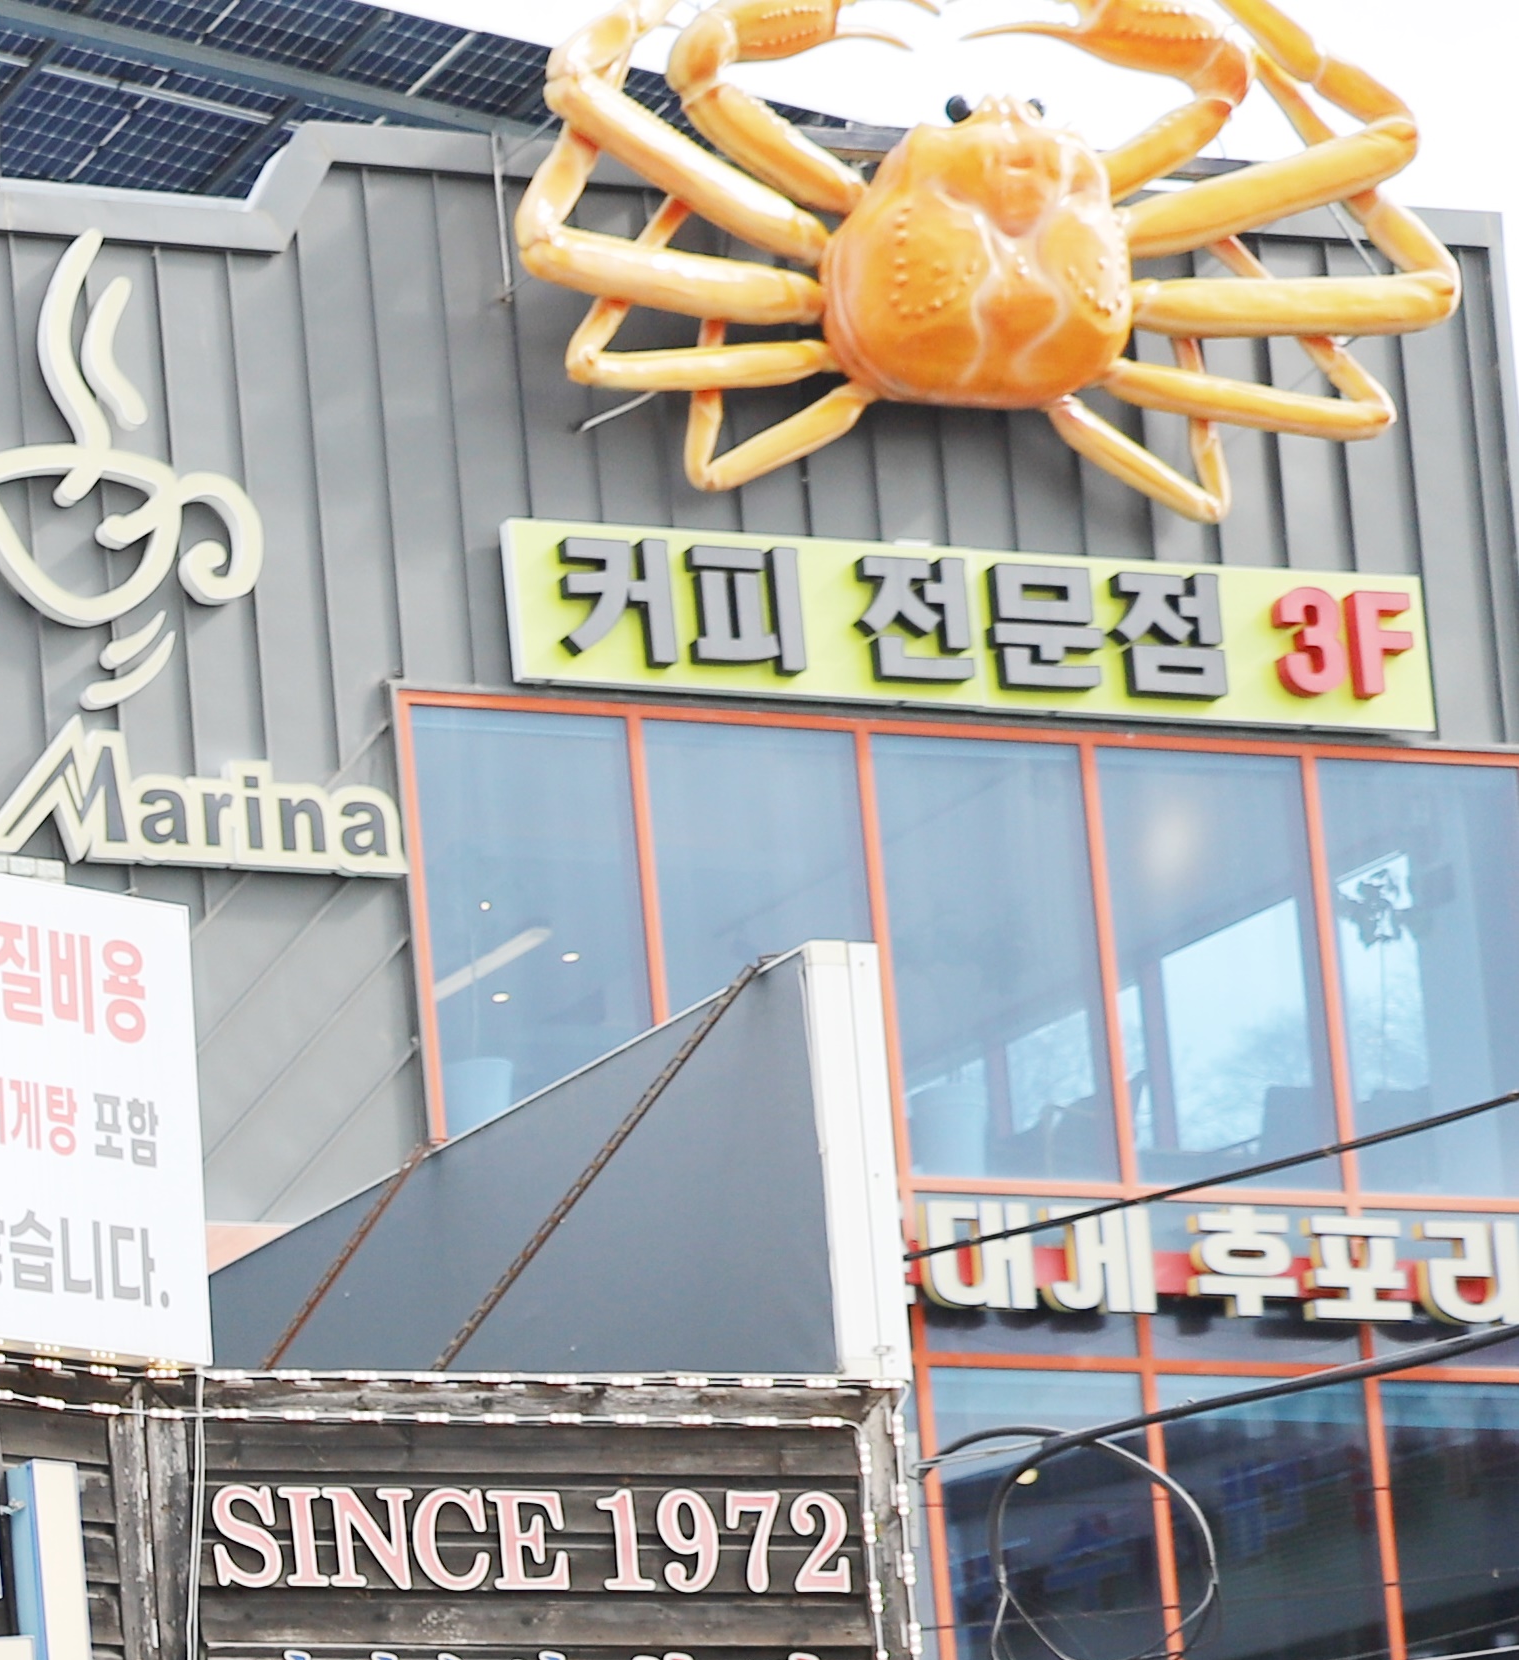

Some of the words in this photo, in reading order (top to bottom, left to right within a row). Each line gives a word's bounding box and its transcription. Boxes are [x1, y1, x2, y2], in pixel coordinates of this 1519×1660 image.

[560, 533, 806, 677] 커피
[856, 551, 1228, 701] 전문점
[1272, 582, 1417, 700] 3F
[92, 1090, 159, 1170] 포함
[906, 1201, 1159, 1315] 대게
[1187, 1206, 1519, 1326] 후포리
[210, 1482, 571, 1592] SINCE
[594, 1487, 852, 1595] 1972
